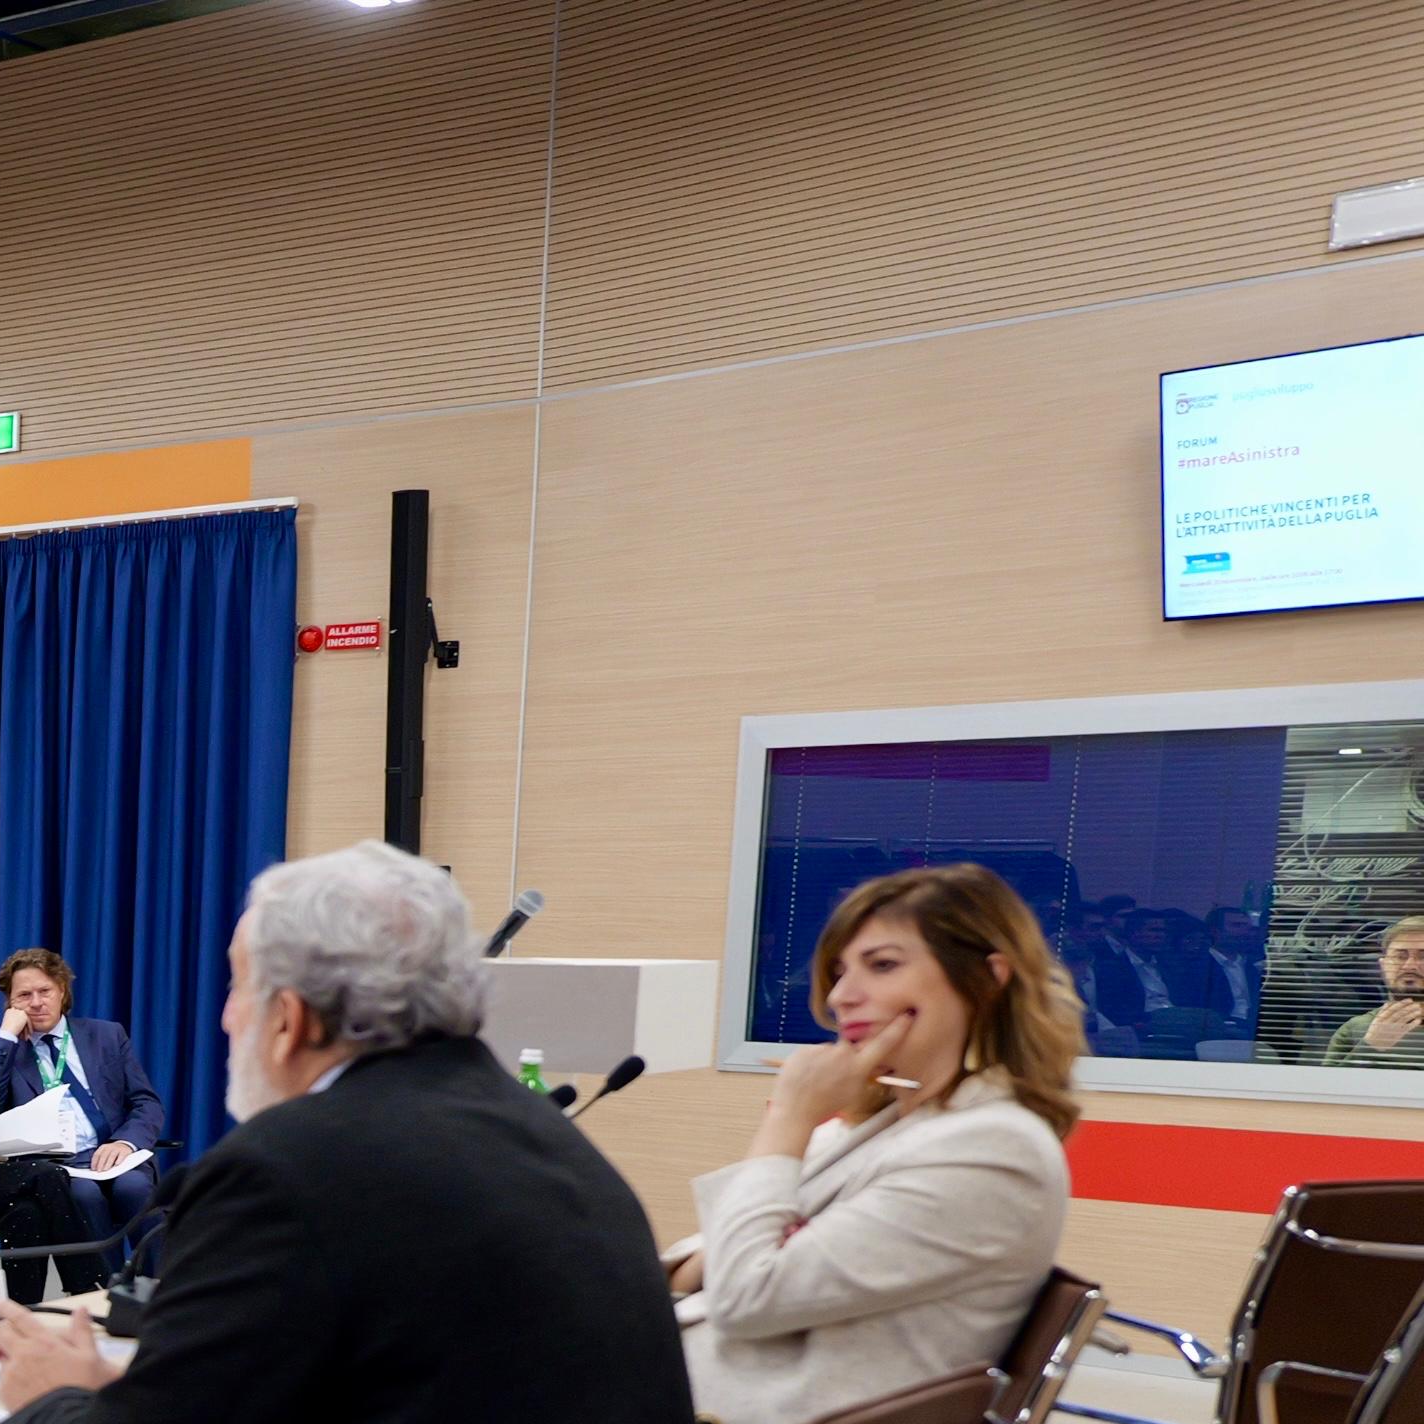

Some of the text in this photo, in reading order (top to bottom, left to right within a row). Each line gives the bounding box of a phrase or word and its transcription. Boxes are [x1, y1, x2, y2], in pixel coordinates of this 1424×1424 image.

[1177, 436, 1218, 450] FORUM
[1178, 446, 1300, 469] #mareAsinistra
[1176, 493, 1371, 524] LE POLITICHE VINCENTI PER
[1278, 513, 1322, 527] DELLA
[1325, 507, 1379, 522] PUGLIA
[329, 625, 377, 636] ALLARME
[327, 636, 377, 647] INCENDIO
